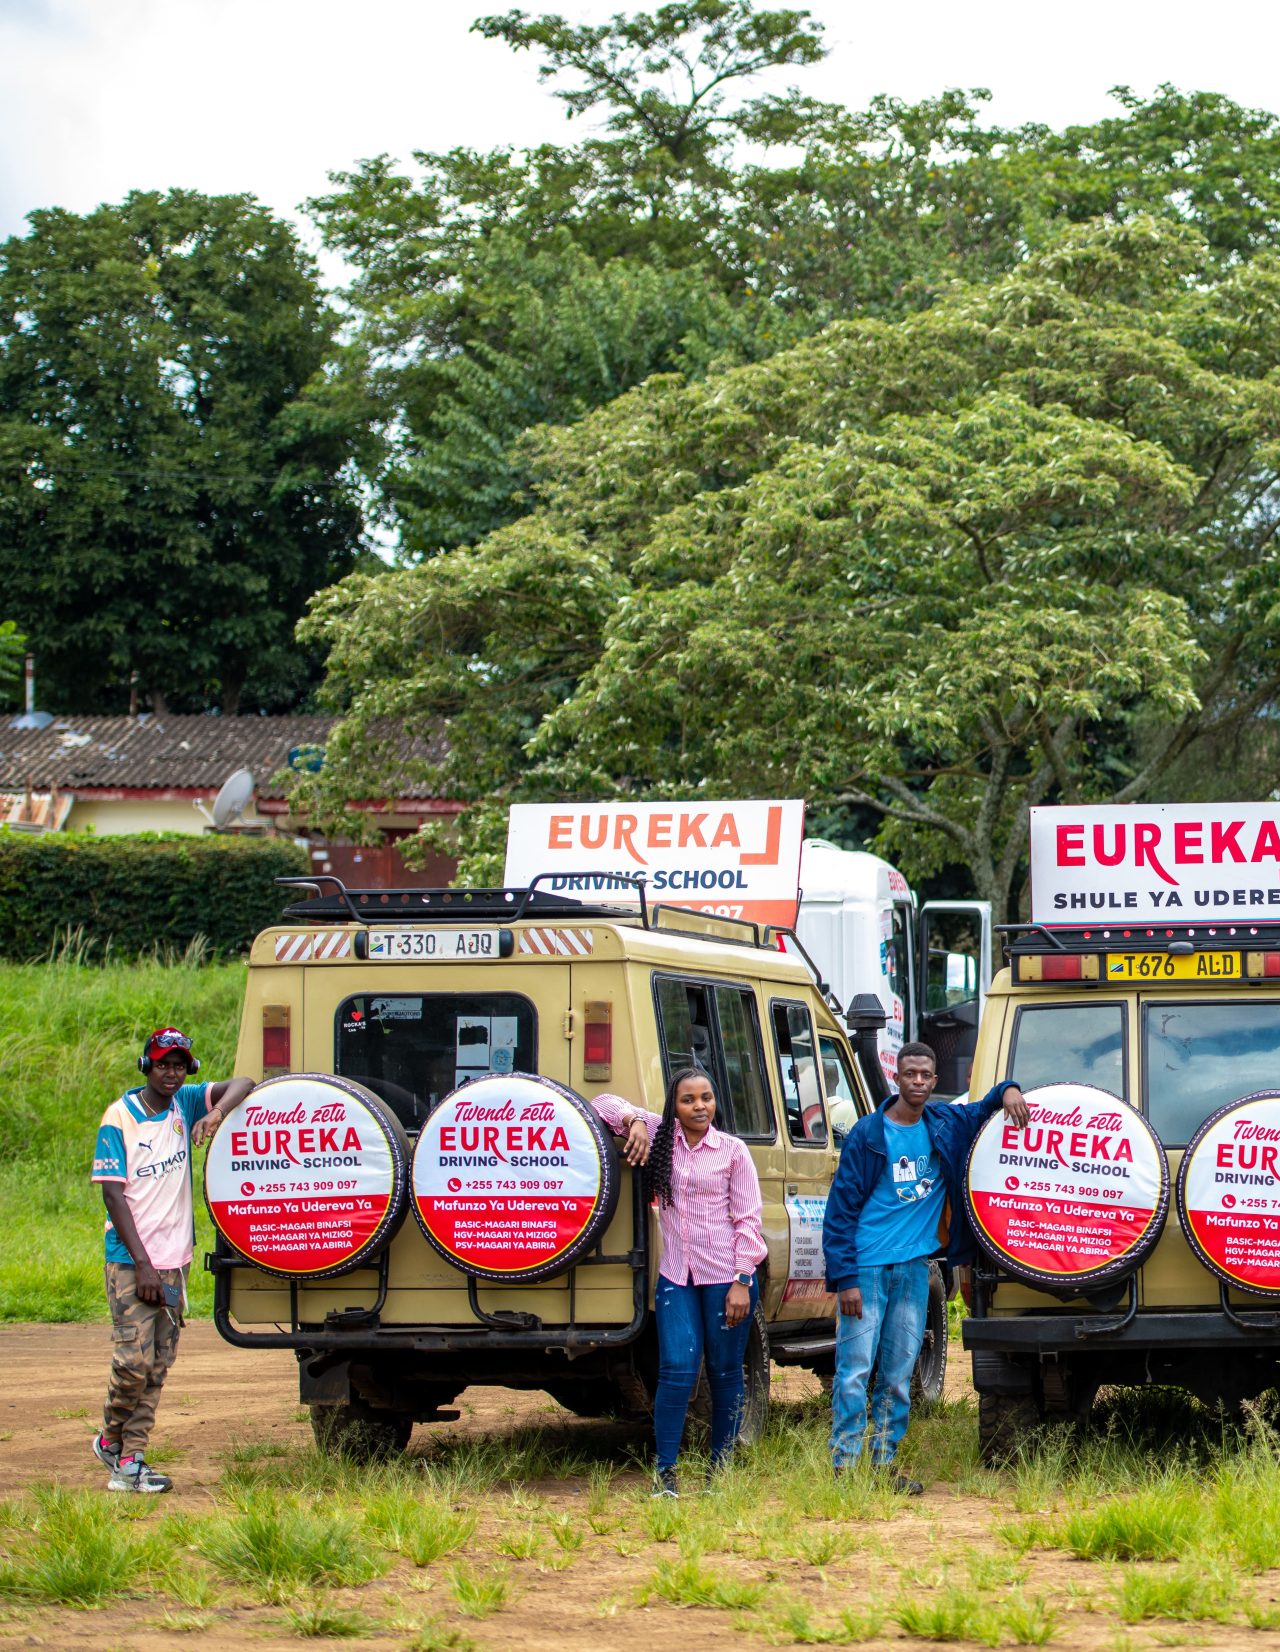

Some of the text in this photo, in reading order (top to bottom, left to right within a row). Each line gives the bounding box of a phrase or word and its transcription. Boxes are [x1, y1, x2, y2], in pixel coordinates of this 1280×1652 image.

[548, 813, 741, 865] EUREKA
[551, 869, 748, 890] DRIVING SCHOOL
[1053, 891, 1138, 910] SHULE
[1148, 891, 1183, 907] YA
[401, 934, 436, 954] 330
[456, 933, 492, 954] AJQ
[1196, 955, 1234, 976] ALD
[246, 1102, 346, 1127] Twende zetu
[455, 1100, 555, 1122] Twende zetu
[1086, 1113, 1122, 1131] zetu
[232, 1127, 362, 1165] EUREKA
[440, 1127, 569, 1163] EUREKA
[1002, 1125, 1133, 1167] EUREKA
[232, 1156, 361, 1171] DRIVING SCHOOL
[440, 1156, 568, 1166] DRIVING SCHOOL
[1000, 1154, 1130, 1177] DRIVING SCHOOL
[260, 1180, 357, 1192] +255 743 909 097
[466, 1181, 563, 1189] +255 743 909 097
[1215, 1173, 1274, 1185] DRIVING
[1024, 1182, 1123, 1199] +255 743 909 097
[228, 1200, 371, 1215] Mafunzo Ya Udereva Ya
[434, 1200, 576, 1210] Mafunzo Ya Udereva Ya
[989, 1196, 1134, 1221] Mafunzo Ya Udereva Ya
[1241, 1199, 1267, 1208] +255
[1207, 1215, 1260, 1228] Mafunzo
[1263, 1219, 1278, 1229] Ya
